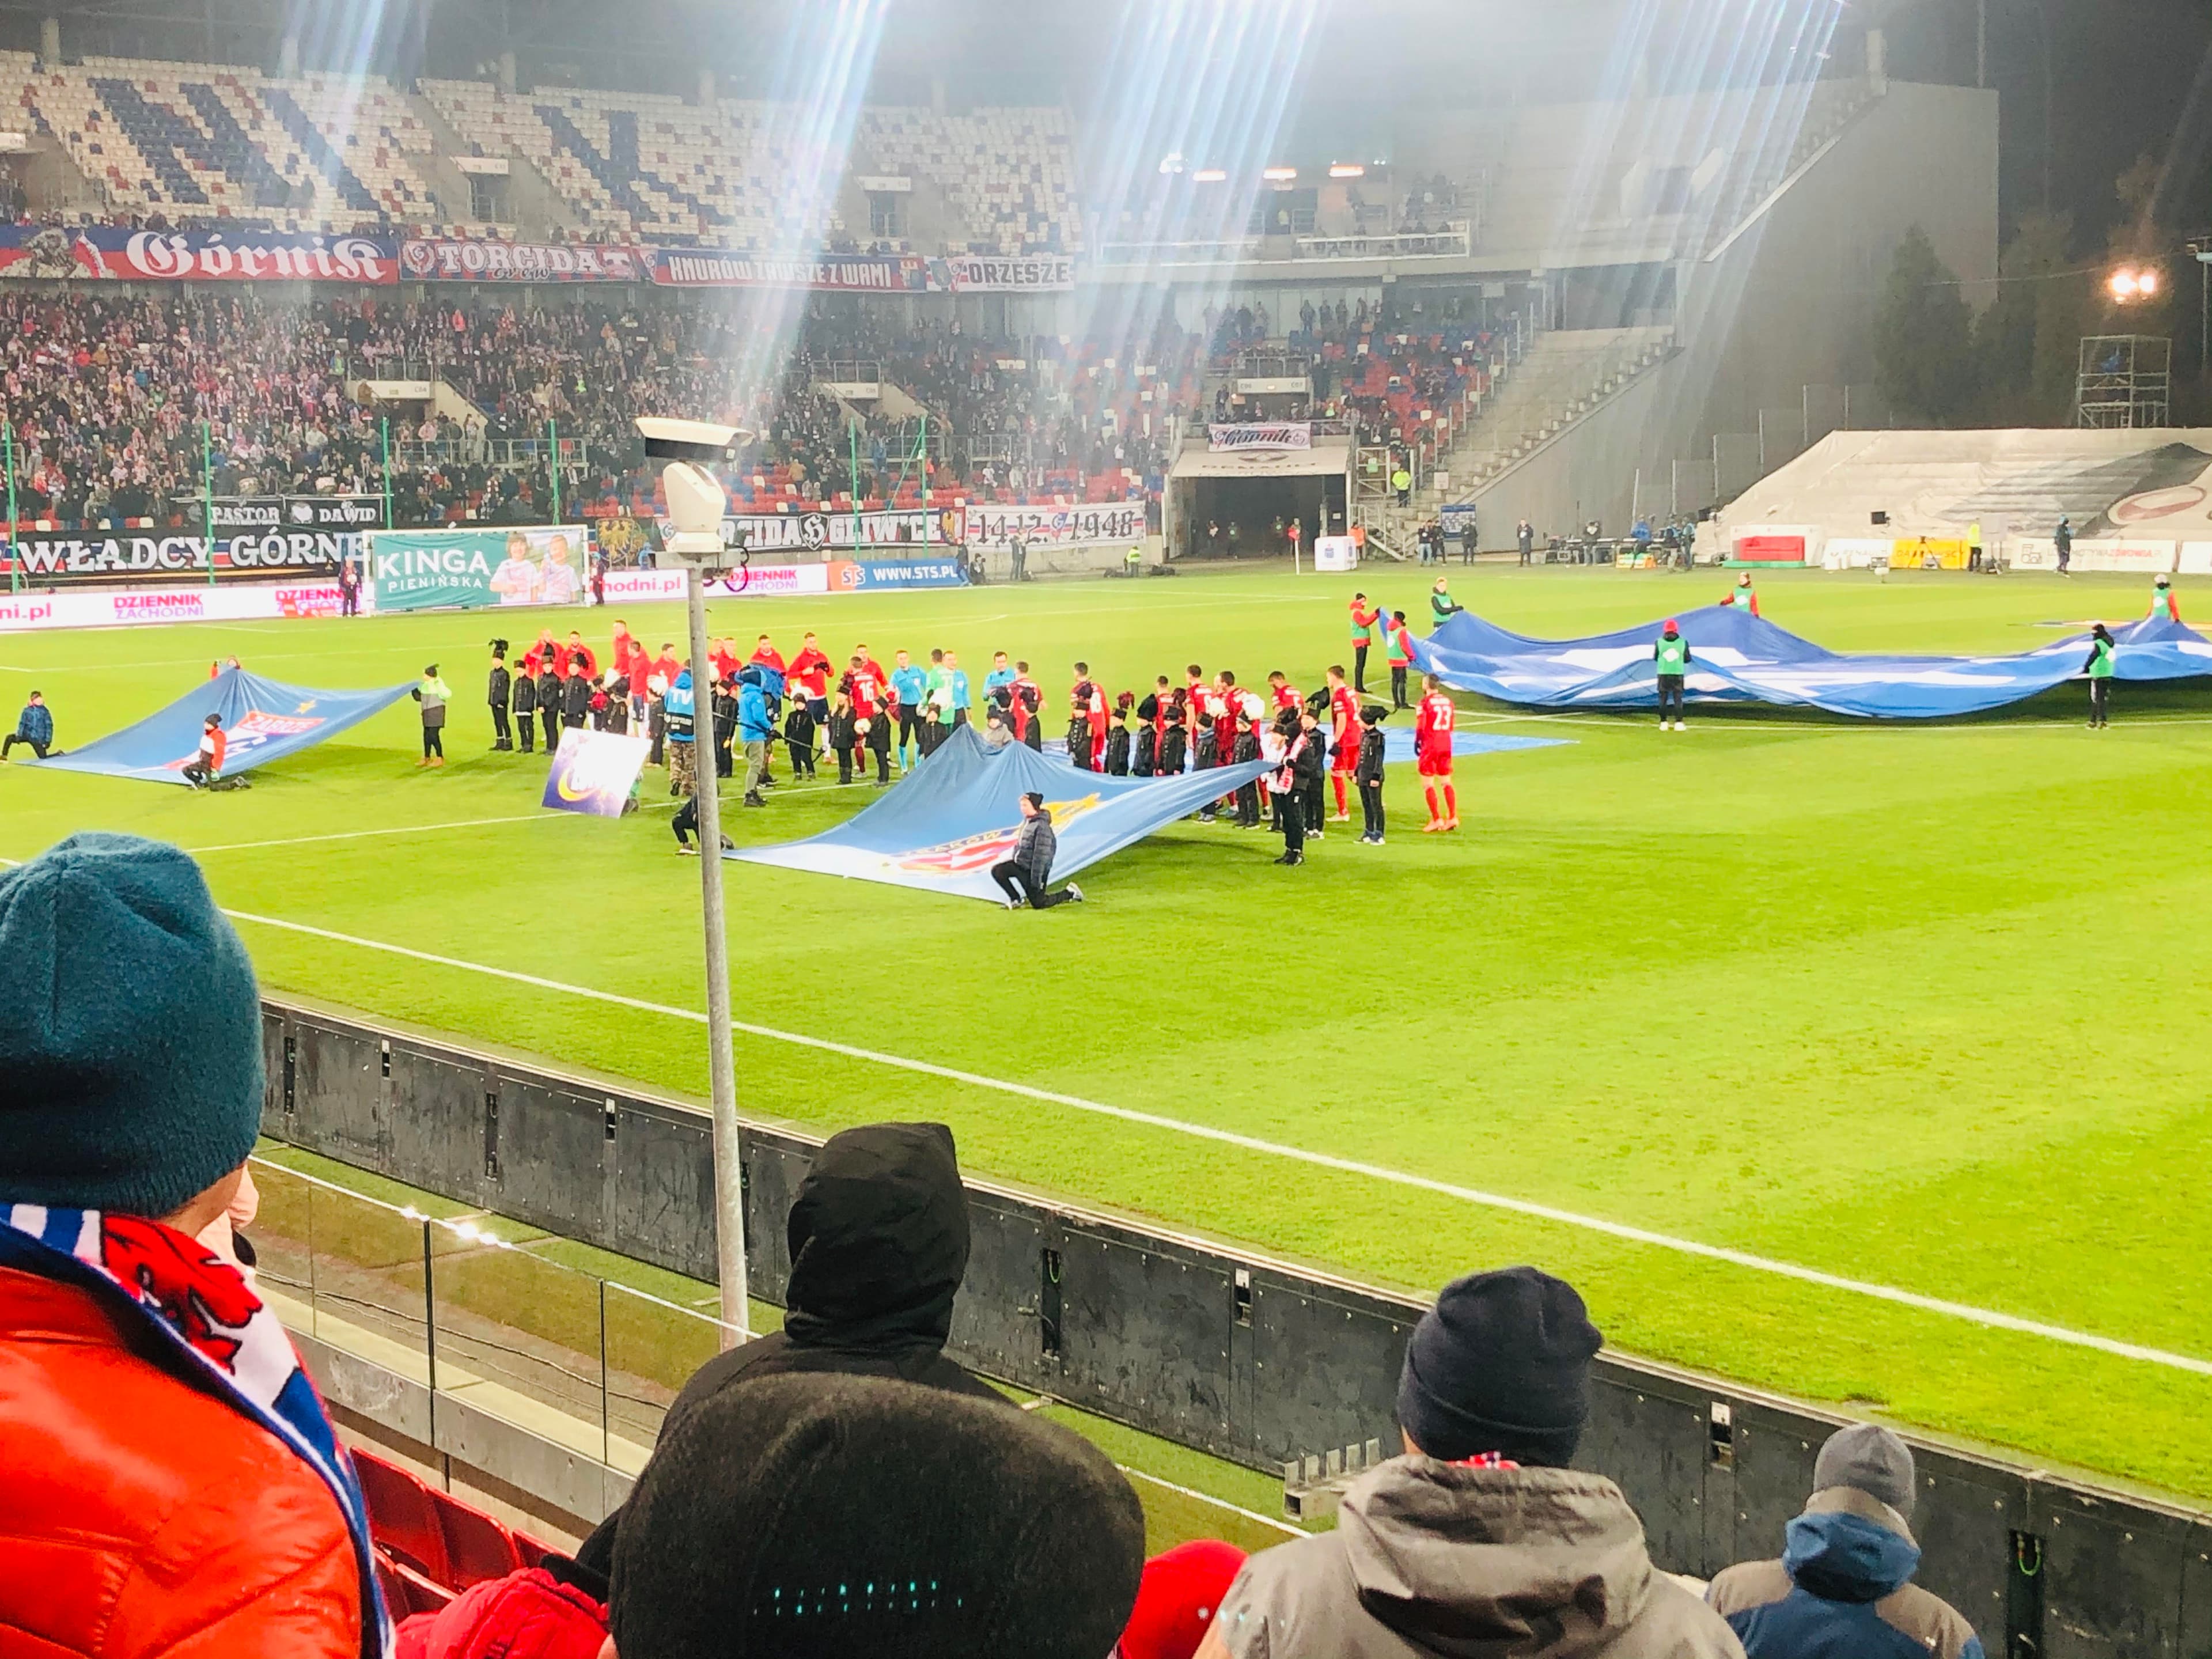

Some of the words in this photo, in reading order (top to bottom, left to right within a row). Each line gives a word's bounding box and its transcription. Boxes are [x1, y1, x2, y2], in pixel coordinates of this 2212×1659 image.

[438, 245, 603, 272] TORCIDA
[841, 263, 892, 287] WAMI
[968, 263, 1069, 284] ORZESZE
[1070, 510, 1135, 540] 1948
[17, 536, 215, 574] WŁADCY
[377, 549, 491, 579] KINGA
[388, 574, 483, 593] PIENIŃSKA
[842, 566, 865, 585] STS
[873, 565, 959, 581] WWW.STS.PL
[113, 593, 202, 608] DZIENNIK
[275, 588, 345, 601] DZIENN
[115, 605, 204, 619] ZACHODNI
[671, 690, 693, 705] TV
[859, 681, 874, 702] 16
[1433, 706, 1452, 730] 23
